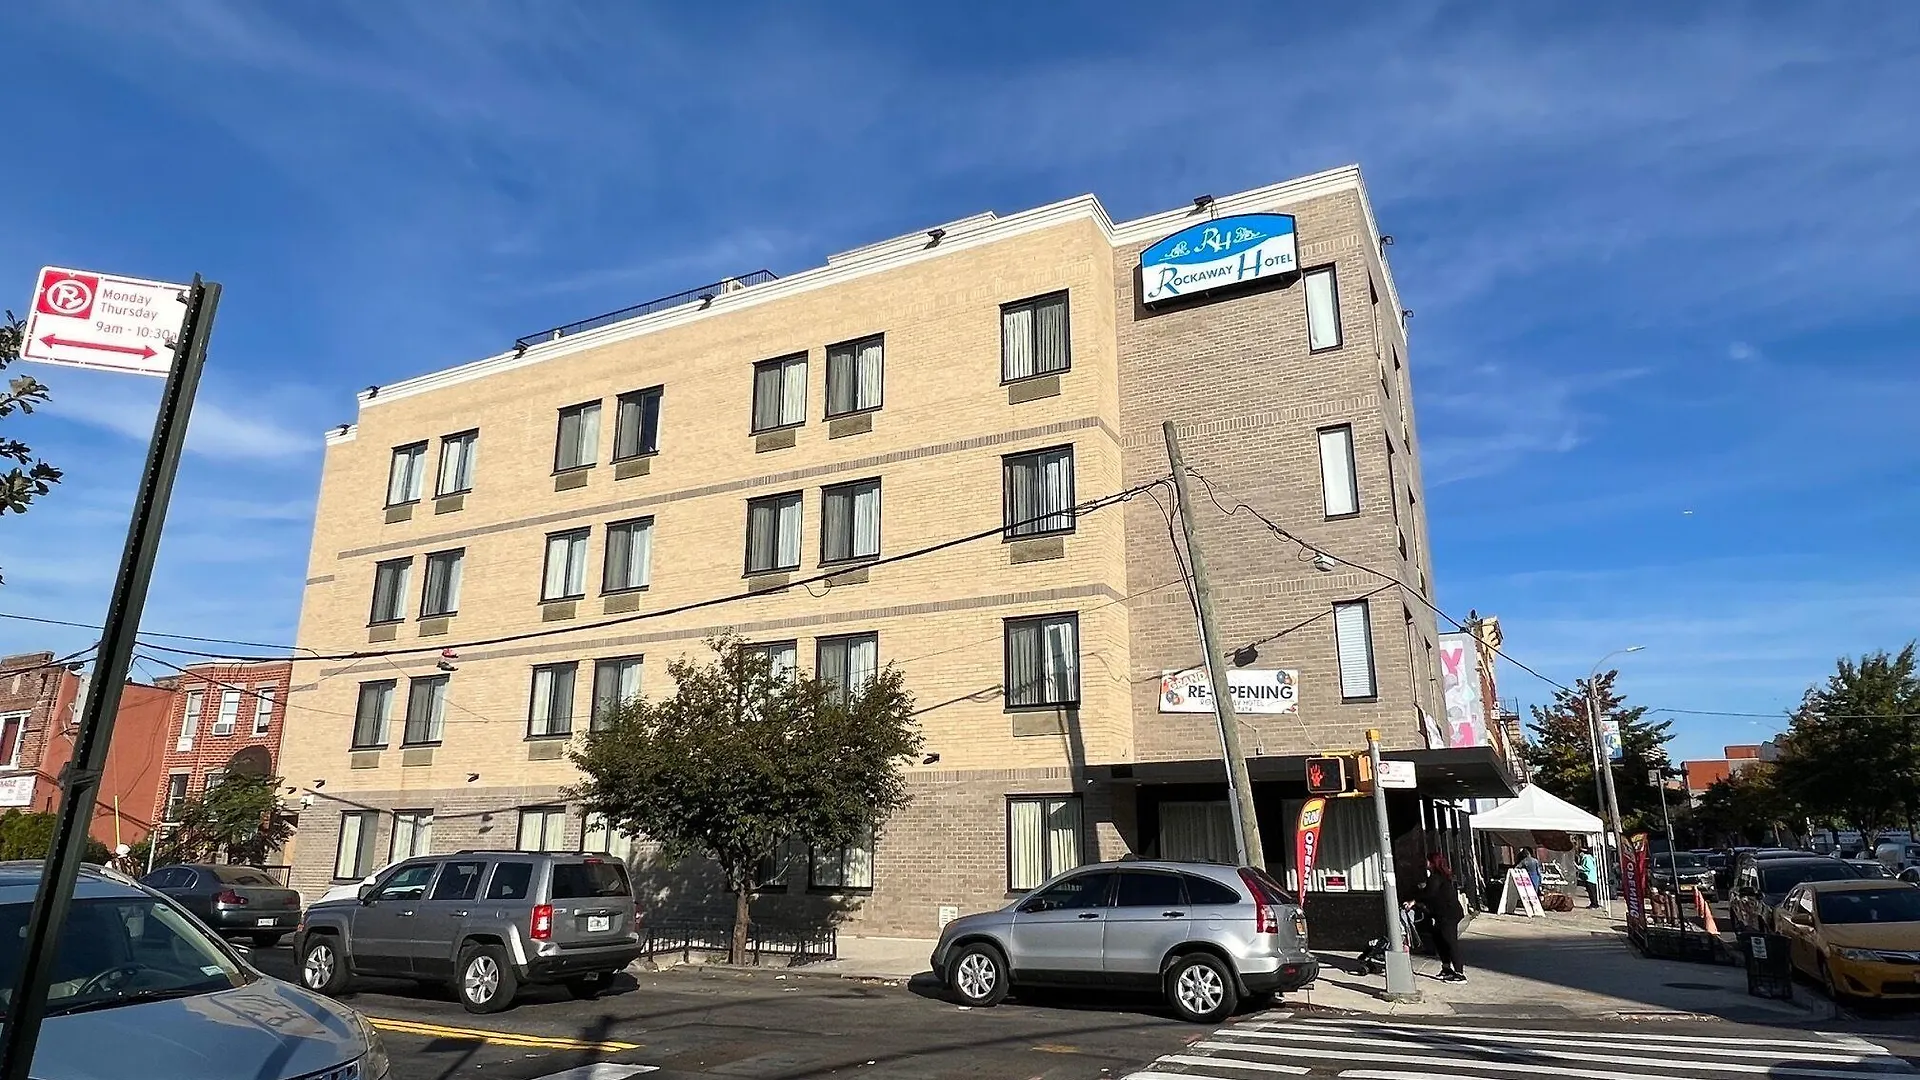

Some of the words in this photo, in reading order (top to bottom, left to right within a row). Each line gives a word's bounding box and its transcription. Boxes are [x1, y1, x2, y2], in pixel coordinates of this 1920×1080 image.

[1193, 226, 1232, 253] RH
[1147, 264, 1233, 298] ROCKAWAY
[1237, 248, 1293, 281] HOTEL
[102, 288, 152, 306] Monday
[100, 302, 160, 321] Thursday
[95, 321, 123, 335] 9am
[136, 326, 178, 341] 10:30a
[1169, 671, 1208, 690] GRAND
[1188, 685, 1293, 700] RE-PENING
